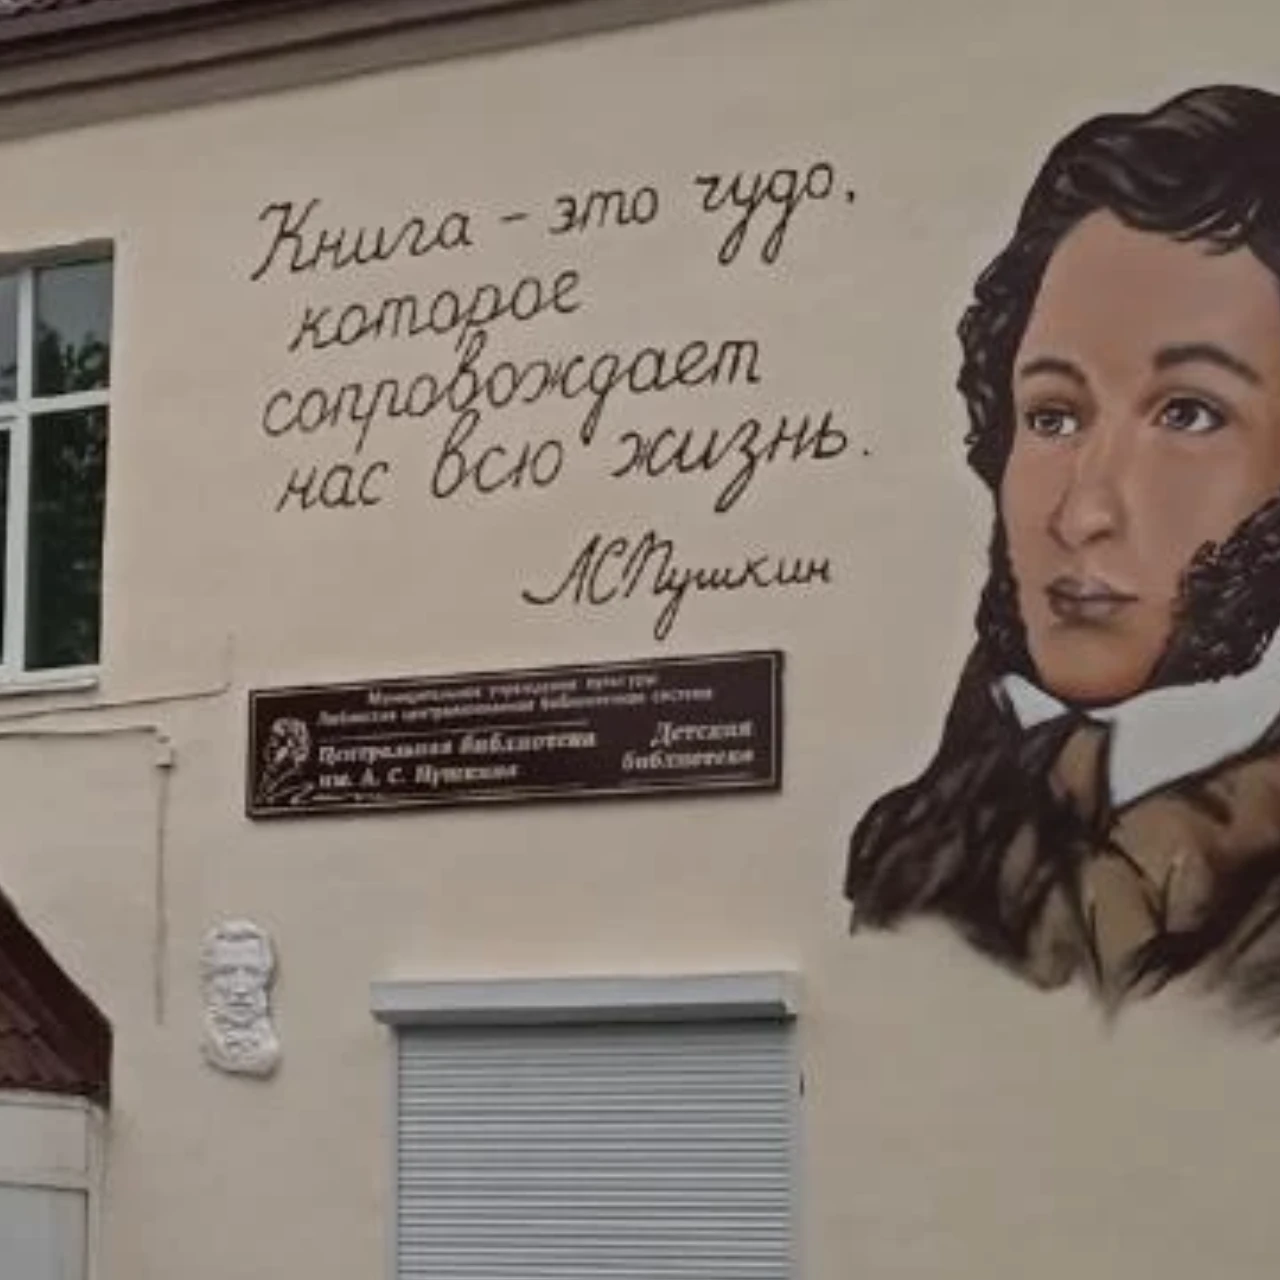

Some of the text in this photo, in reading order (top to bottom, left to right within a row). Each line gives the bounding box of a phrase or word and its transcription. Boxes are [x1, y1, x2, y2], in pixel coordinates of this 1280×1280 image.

[251, 198, 474, 282] Книга
[548, 185, 660, 236] это
[288, 270, 583, 353] которое
[261, 328, 762, 453] сопровождает
[275, 460, 389, 513] нас
[431, 408, 564, 499] всю
